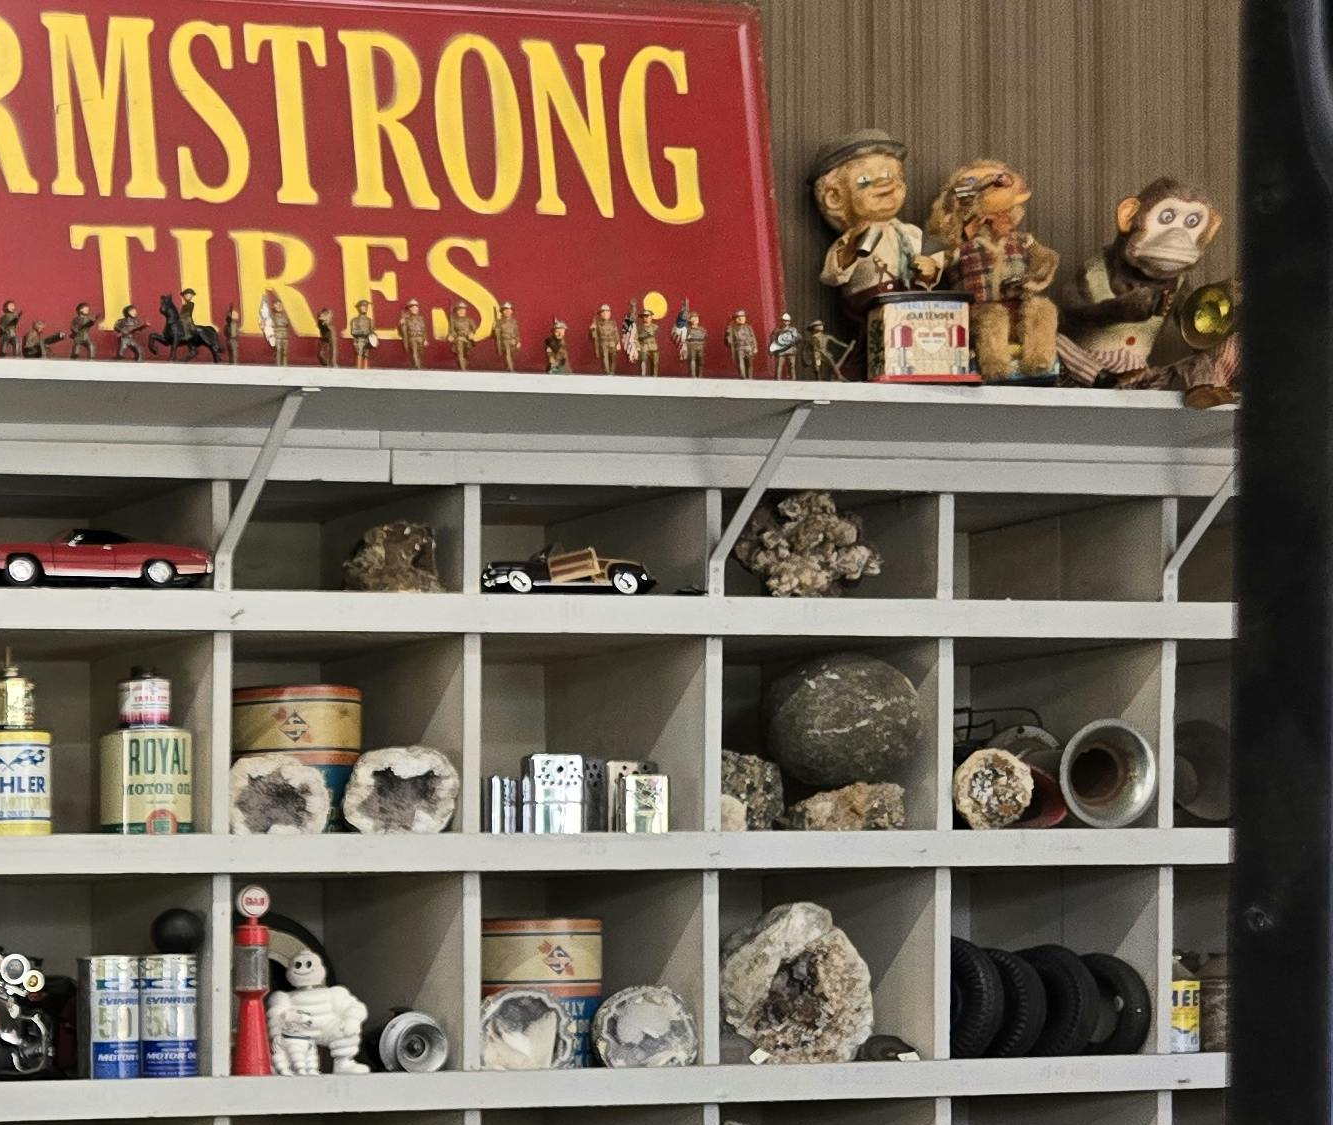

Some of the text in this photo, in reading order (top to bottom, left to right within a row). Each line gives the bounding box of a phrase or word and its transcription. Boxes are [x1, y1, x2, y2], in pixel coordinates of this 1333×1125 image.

[70, 225, 499, 344] TIRES
[128, 738, 188, 776] ROYAL
[124, 783, 174, 796] MOTOR
[97, 1053, 136, 1061] MOTOR
[147, 1052, 185, 1060] MOTOR
